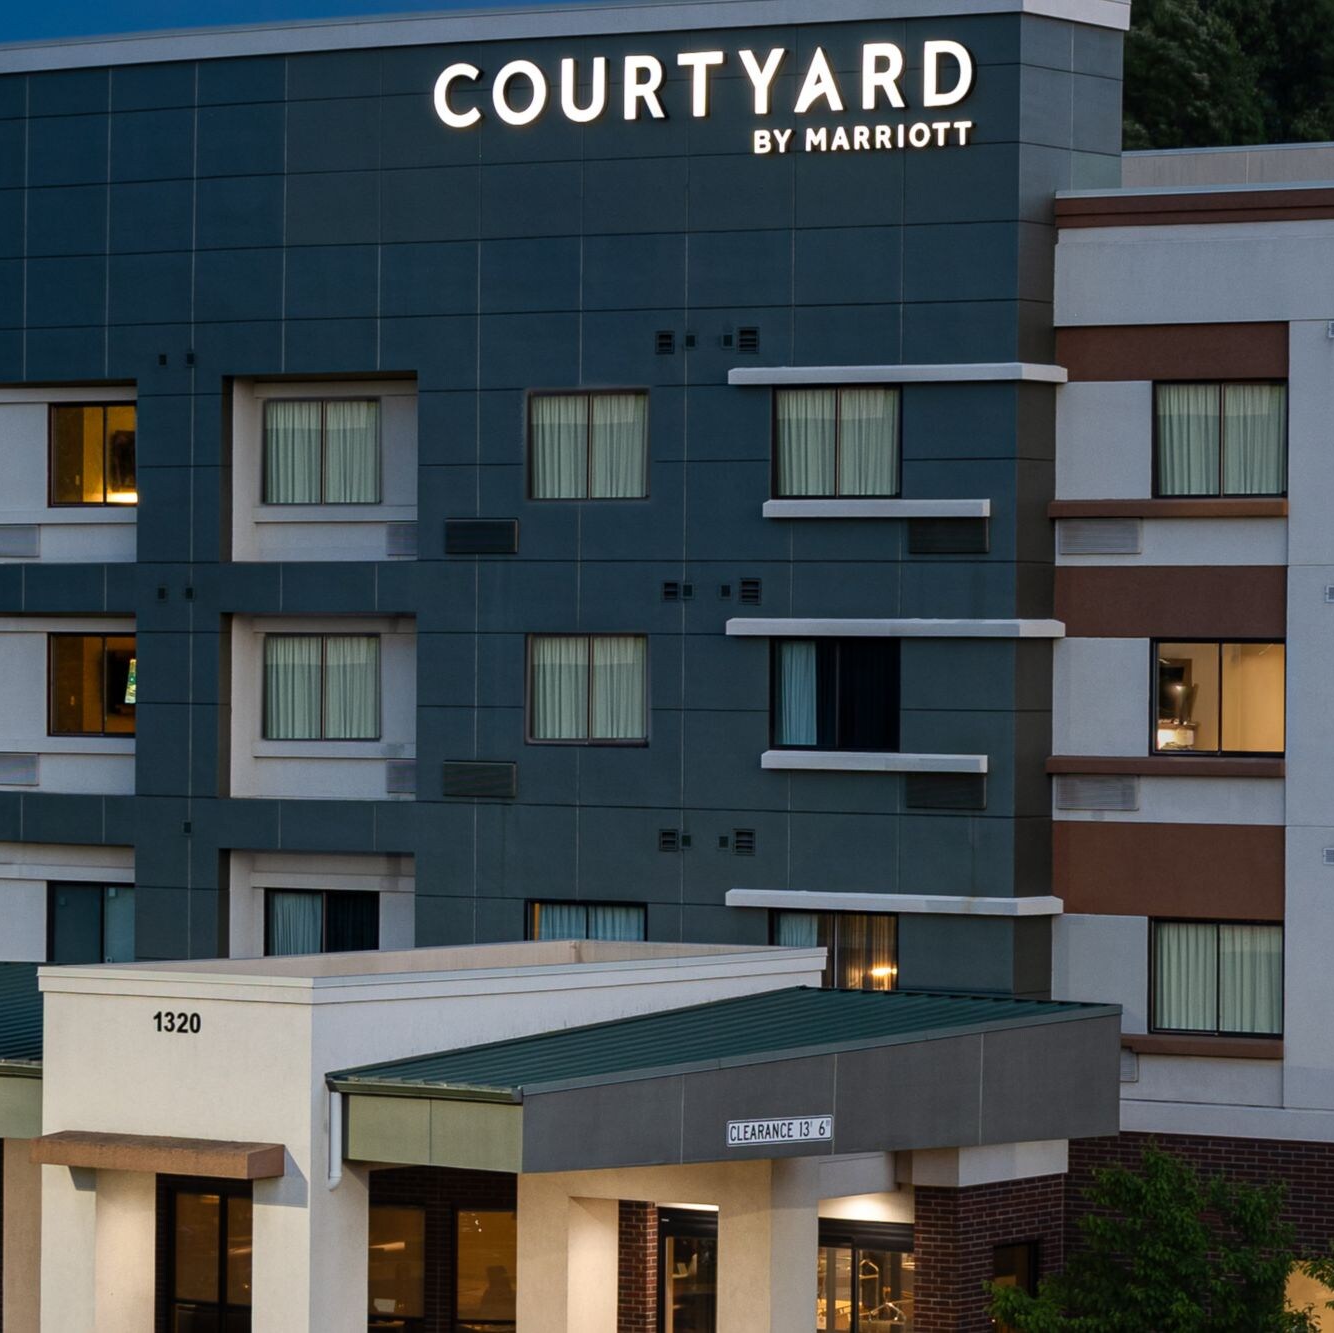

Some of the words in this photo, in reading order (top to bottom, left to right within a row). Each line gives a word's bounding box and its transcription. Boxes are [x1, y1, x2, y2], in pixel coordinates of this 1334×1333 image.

[433, 40, 973, 128] COURTYARD
[753, 128, 792, 154] BY
[805, 120, 972, 152] MARRIOTT
[153, 1011, 202, 1034] 1320
[729, 1121, 794, 1142] CLEARANCE
